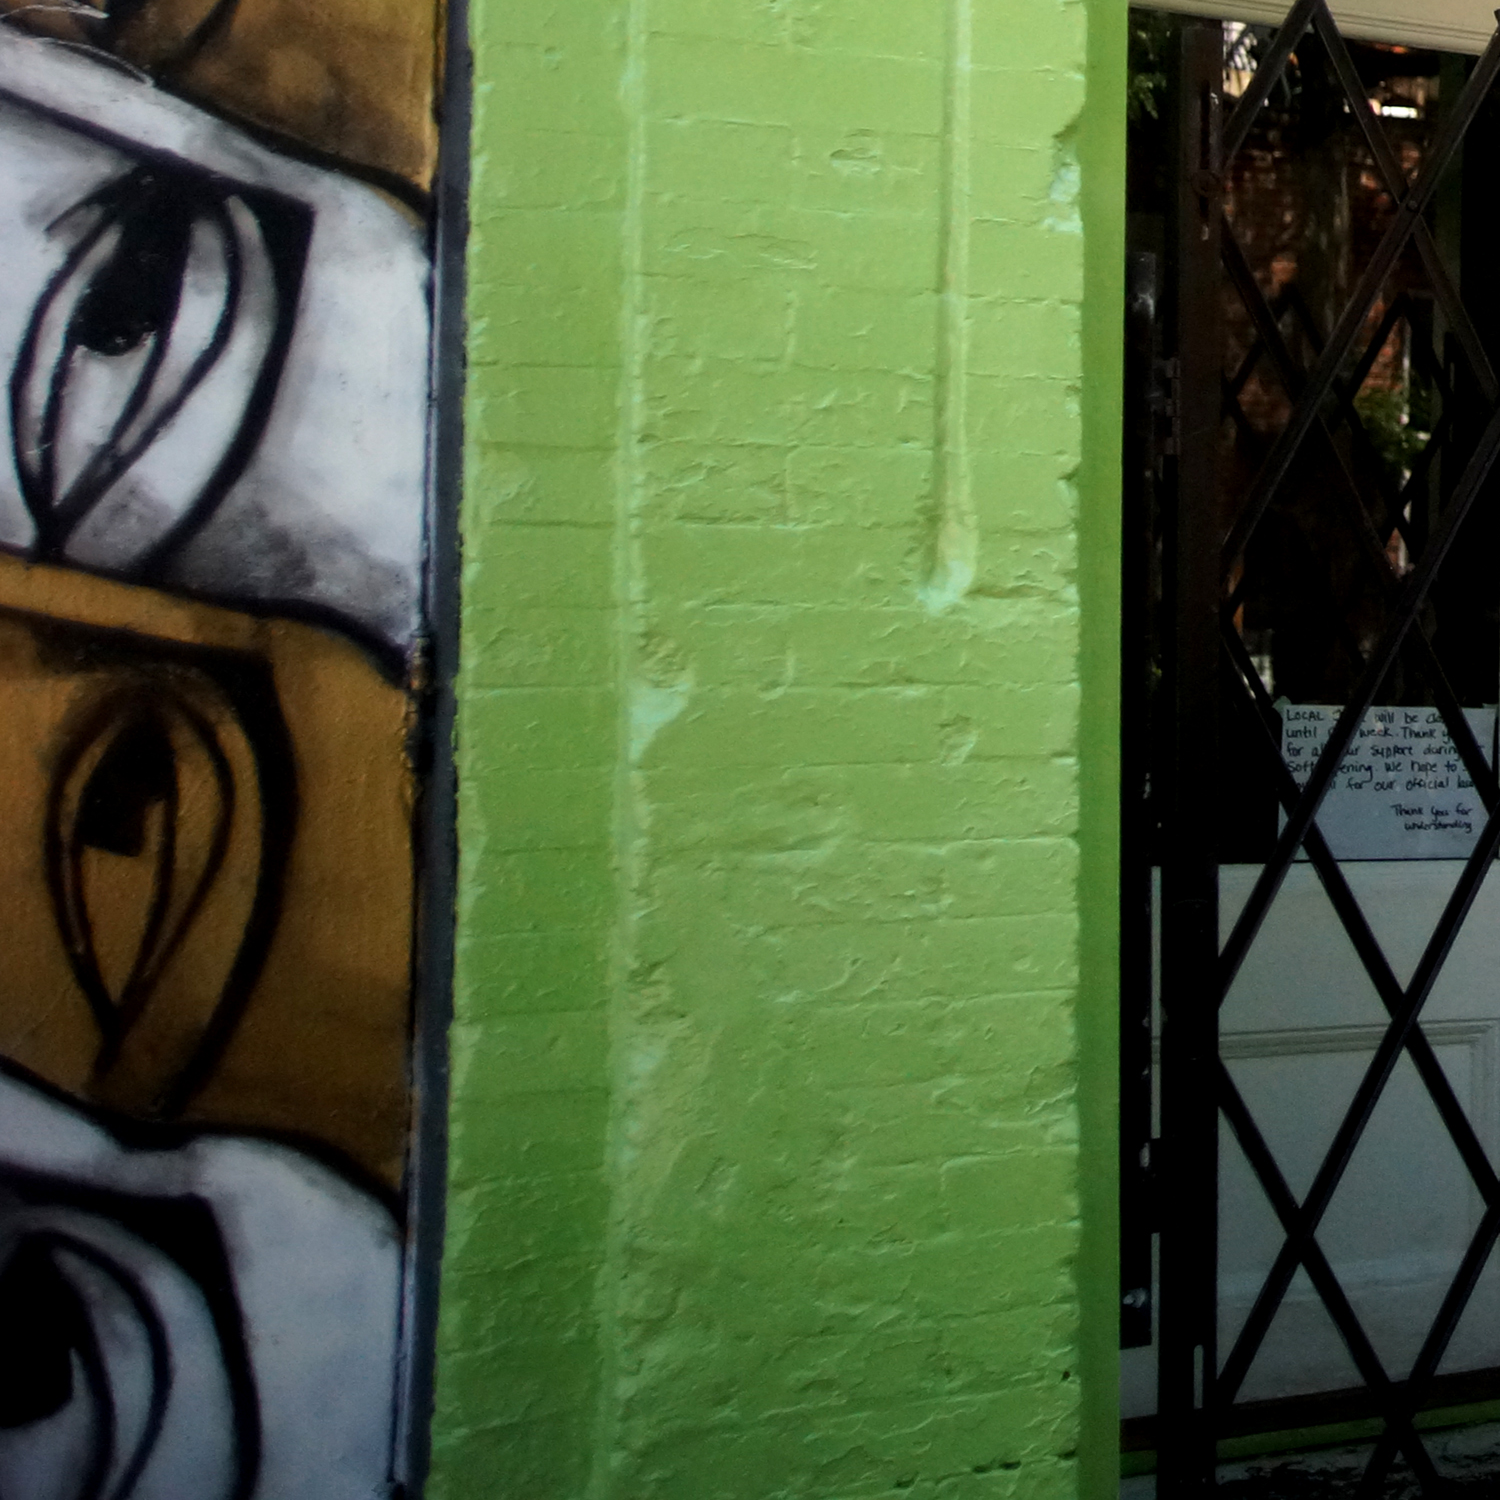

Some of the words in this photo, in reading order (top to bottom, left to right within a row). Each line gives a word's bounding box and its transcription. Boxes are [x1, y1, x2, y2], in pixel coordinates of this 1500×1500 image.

[1285, 708, 1325, 722] LOCAL
[1404, 711, 1419, 724] be
[1286, 726, 1318, 739] until
[1401, 726, 1436, 739] Thank
[1286, 744, 1308, 758] for
[1445, 761, 1458, 773] to
[1374, 779, 1395, 792] our
[1391, 803, 1424, 817] Thank
